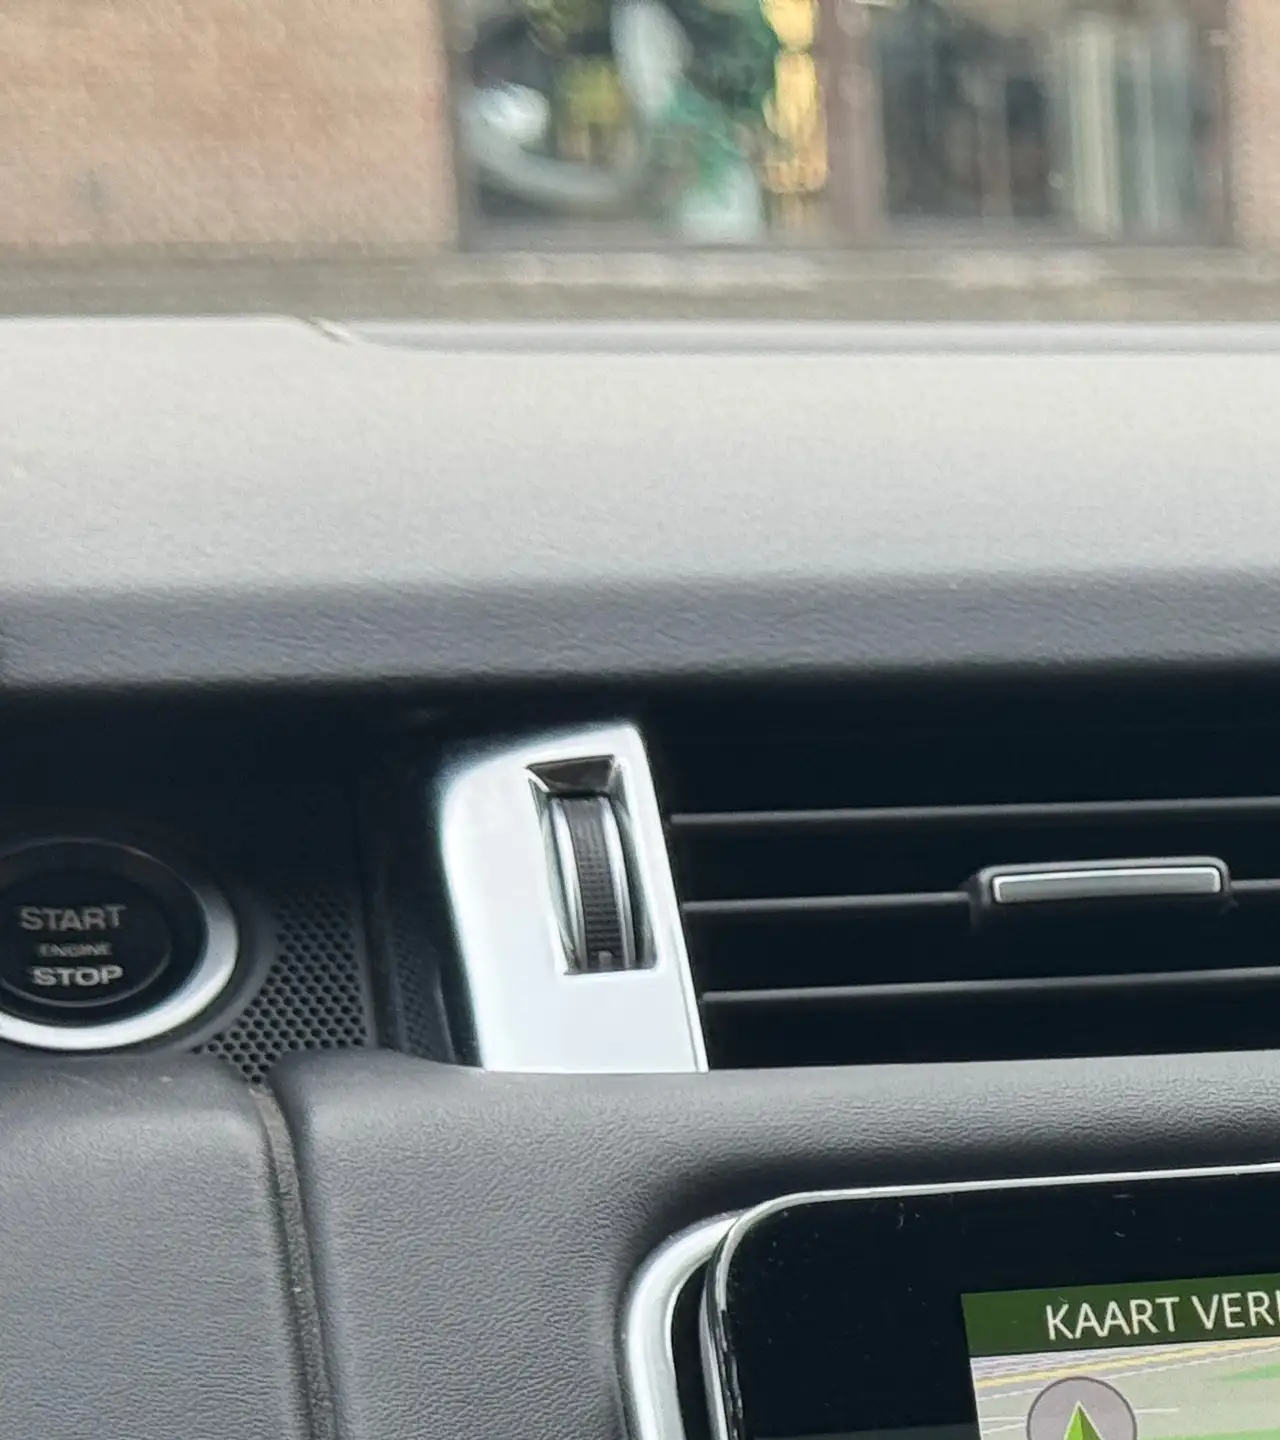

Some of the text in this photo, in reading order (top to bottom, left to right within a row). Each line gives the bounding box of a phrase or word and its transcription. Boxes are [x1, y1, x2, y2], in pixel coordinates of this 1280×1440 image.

[20, 903, 126, 931] START
[31, 965, 123, 987] STOP
[1045, 1297, 1179, 1341] KAART
